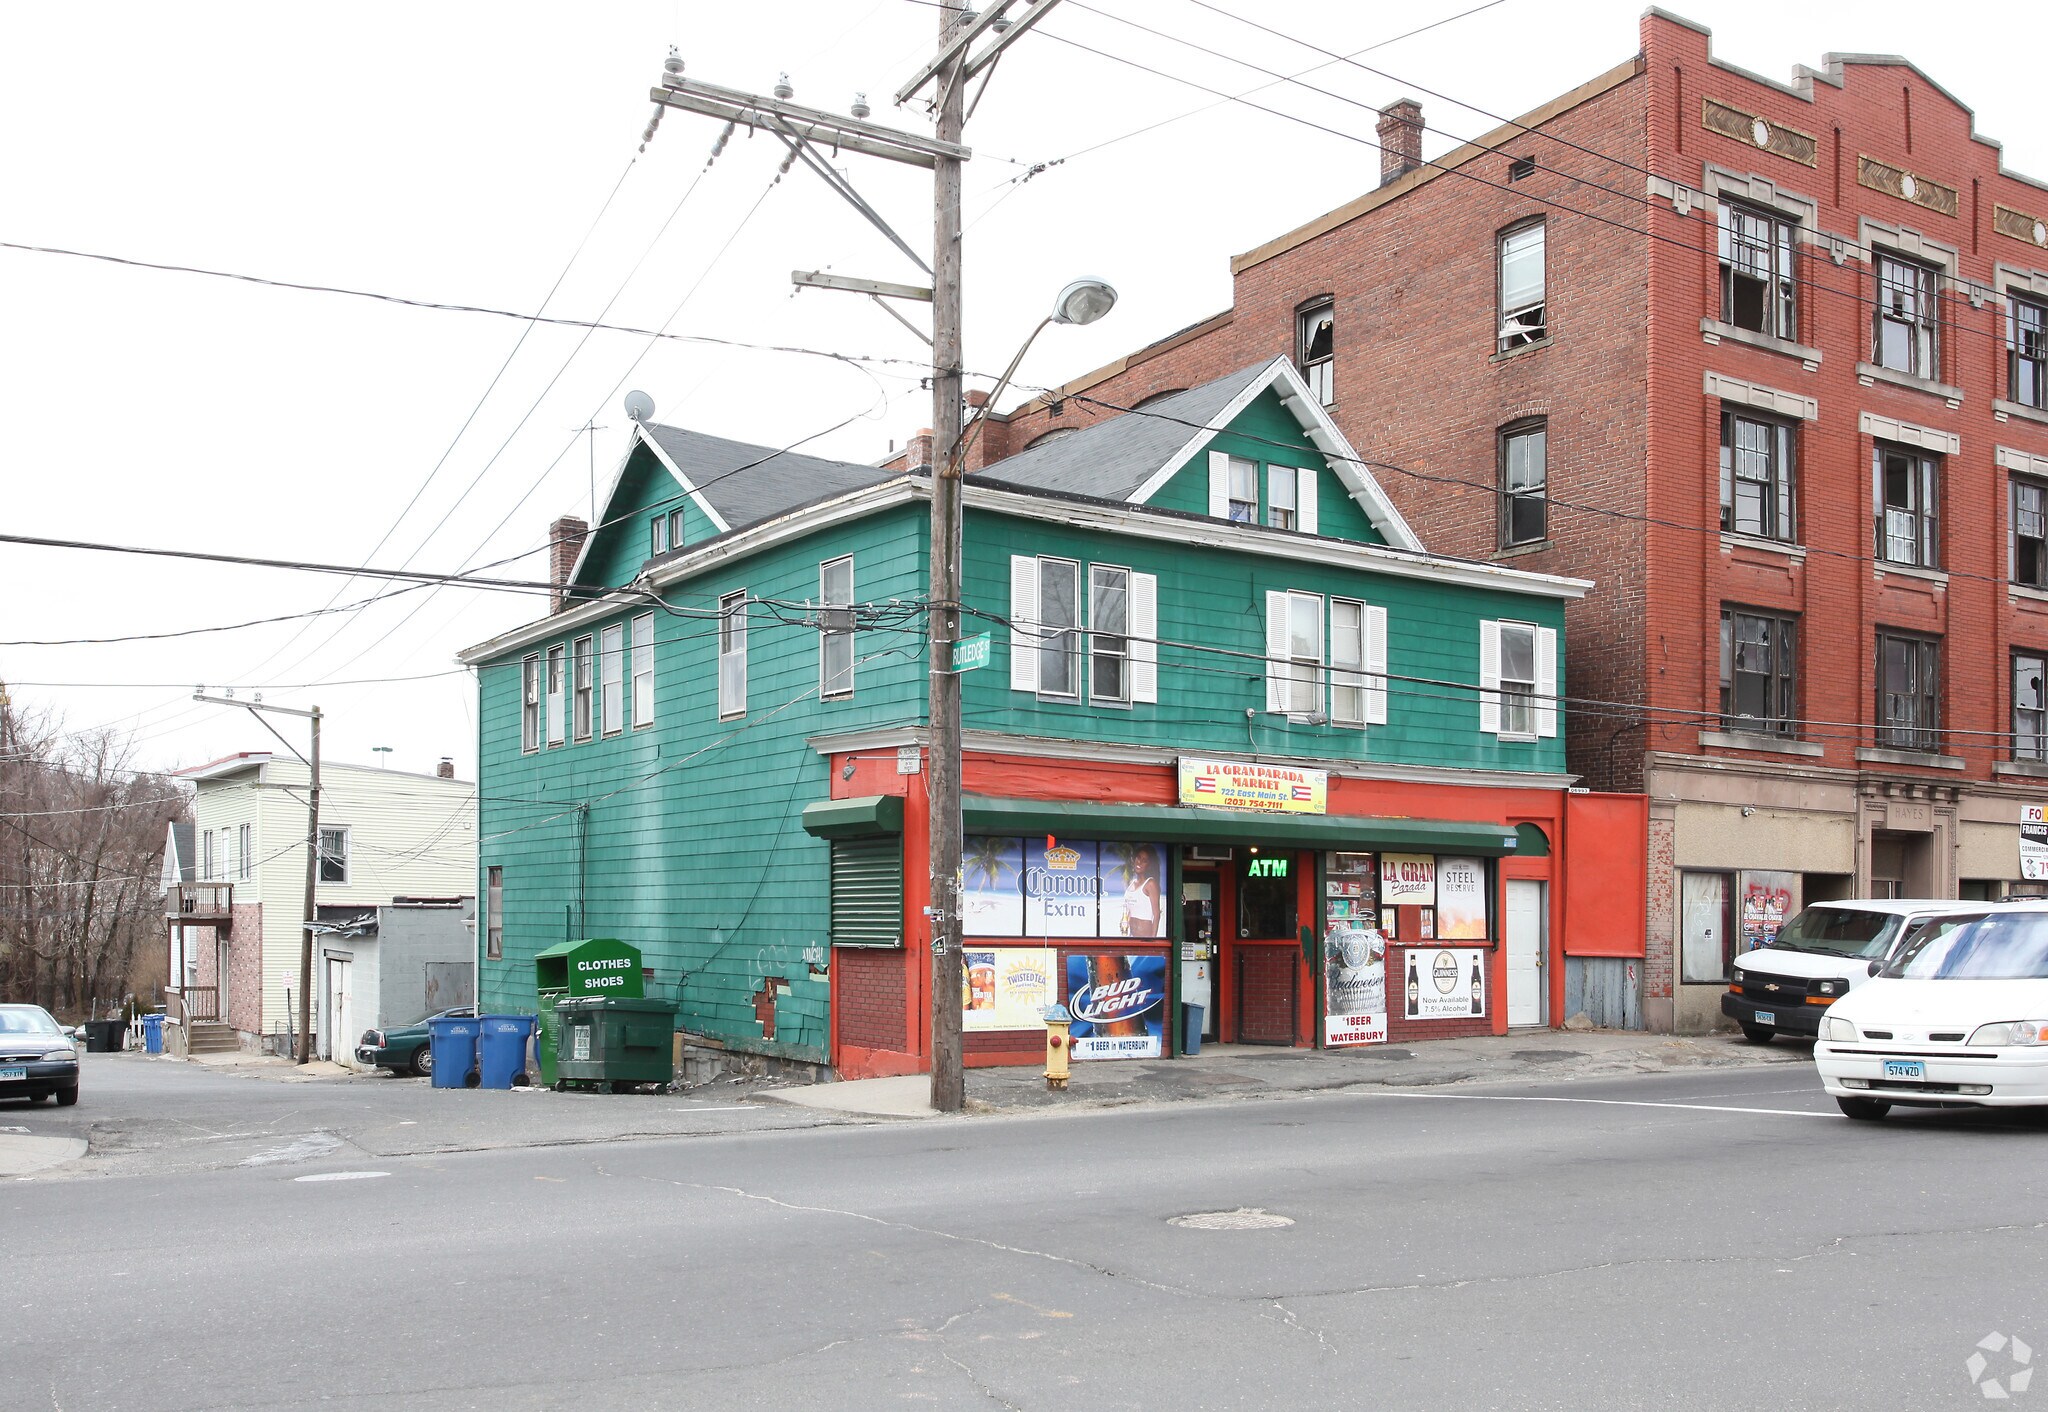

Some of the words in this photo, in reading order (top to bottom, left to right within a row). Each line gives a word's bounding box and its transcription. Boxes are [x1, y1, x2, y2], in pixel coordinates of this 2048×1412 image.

[953, 641, 984, 666] RUTLEDGE
[1206, 765, 1220, 775] LA
[1223, 766, 1255, 777] GRAN
[1257, 768, 1304, 783] PARADA
[1232, 777, 1280, 790] MARKET
[1221, 788, 1234, 796] 722
[1237, 790, 1255, 798] East
[1258, 791, 1276, 799] Main
[1225, 798, 1246, 807] (203)
[1249, 800, 1283, 809] 754-7111
[1896, 807, 1924, 820] HAYES
[2029, 808, 2042, 820] FO
[2022, 825, 2047, 836] FRANCIS
[1248, 859, 1287, 877] ATM
[1383, 862, 1397, 881] LA
[1401, 862, 1433, 882] GRAN
[1446, 872, 1474, 883] STEEL
[1016, 867, 1106, 902] Corona
[1391, 880, 1426, 892] Parada
[1446, 884, 1475, 892] RESERVE
[1044, 897, 1085, 917] Extra
[578, 959, 631, 971] CLOTHES
[1007, 973, 1034, 985] TWISTED
[1035, 974, 1046, 985] TEA
[1433, 969, 1458, 977] GUINNESS
[585, 976, 624, 988] SHOES
[1090, 977, 1141, 1001] BUD
[1082, 989, 1152, 1018] LIGHT
[1331, 1031, 1384, 1042] WATERBURY
[1096, 1041, 1109, 1050] BEER
[1111, 1041, 1116, 1050] in
[1119, 1041, 1149, 1050] WATERBURY
